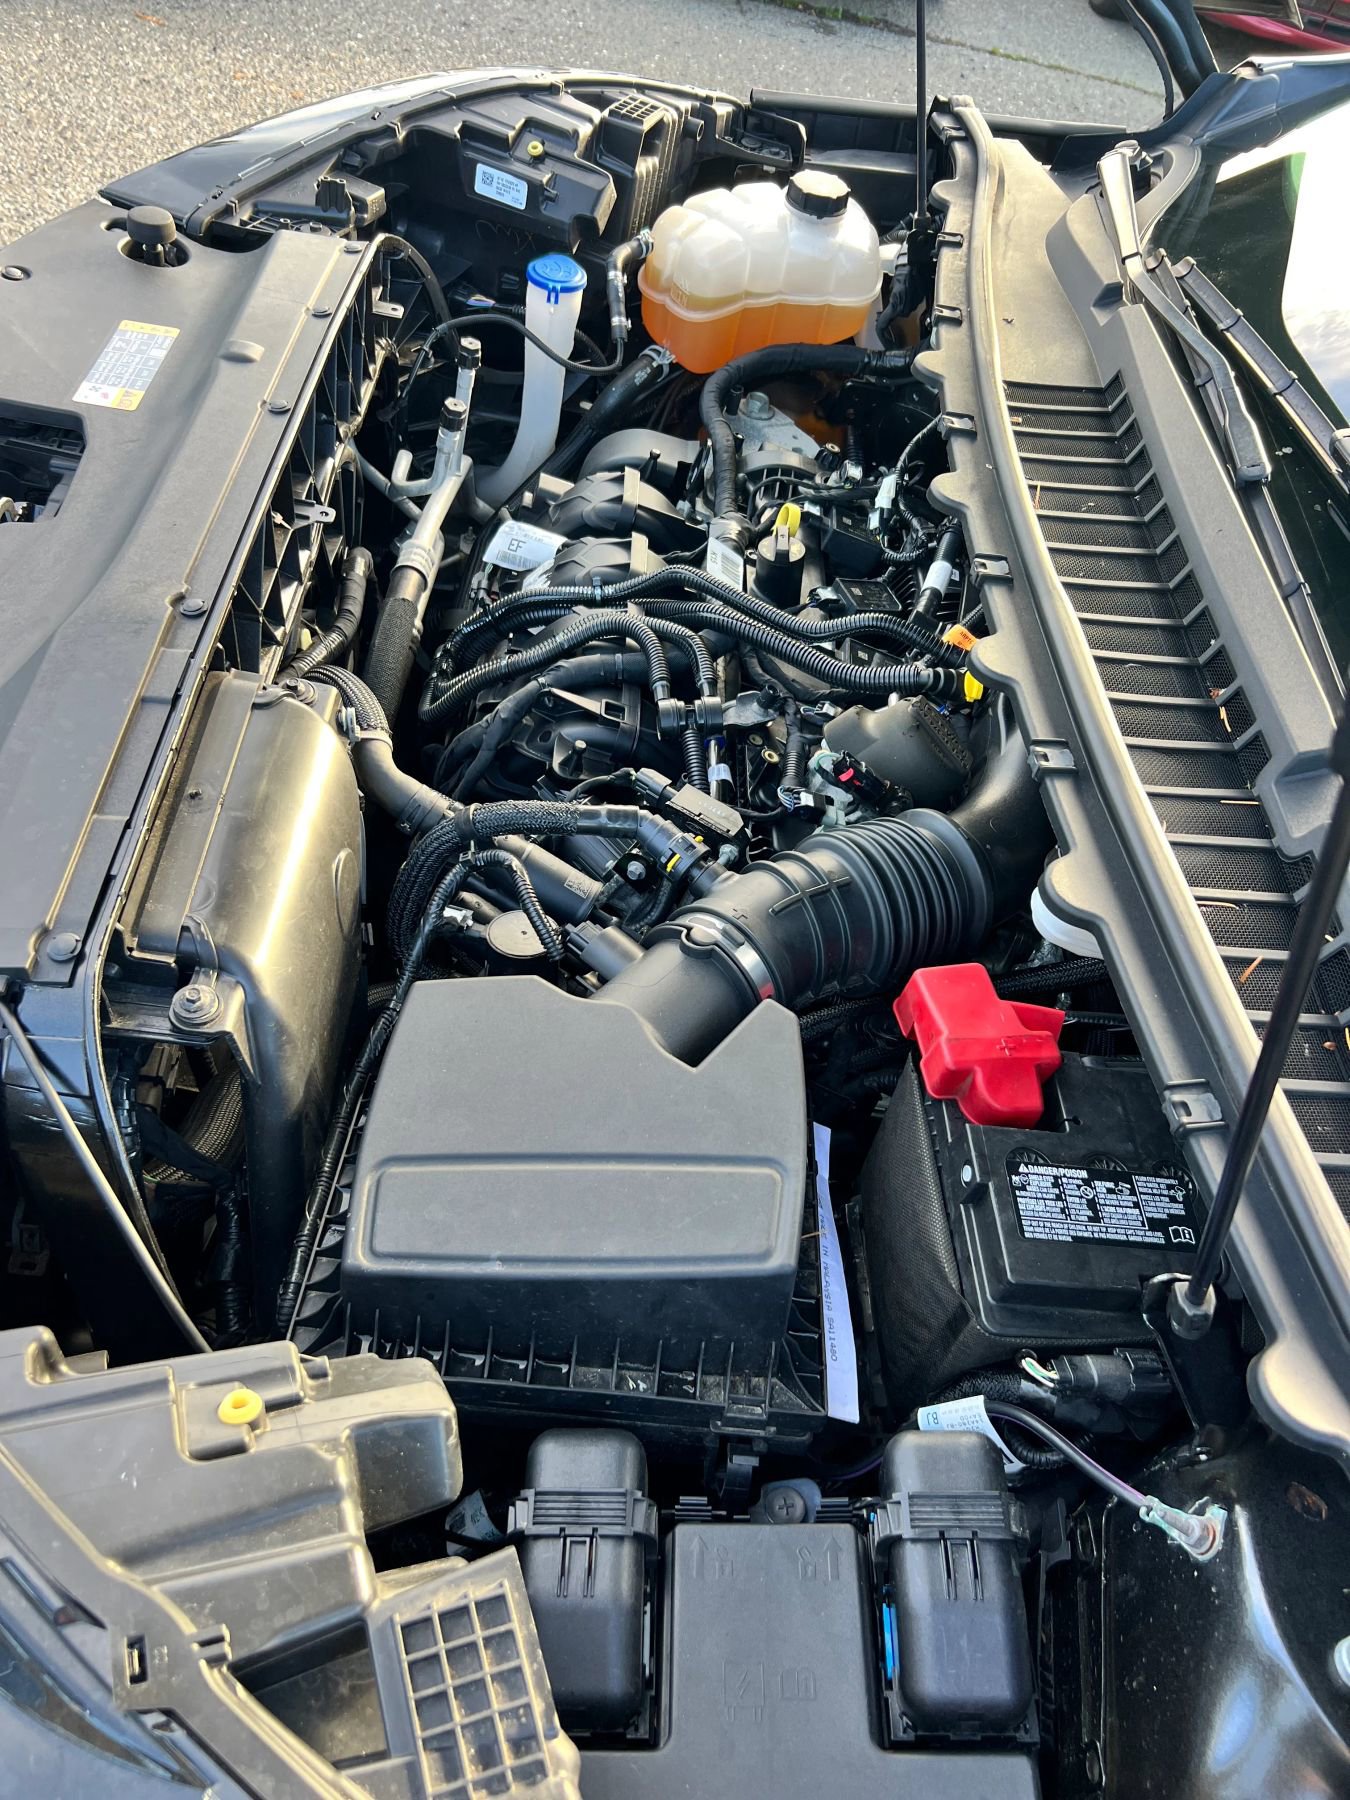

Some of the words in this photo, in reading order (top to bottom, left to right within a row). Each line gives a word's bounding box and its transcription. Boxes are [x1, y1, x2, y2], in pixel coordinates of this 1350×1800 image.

[508, 538, 526, 552] EF
[1028, 1164, 1088, 1178] DANGER/POISON
[822, 1260, 833, 1312] MALAYSIA
[926, 1412, 939, 1425] BJ
